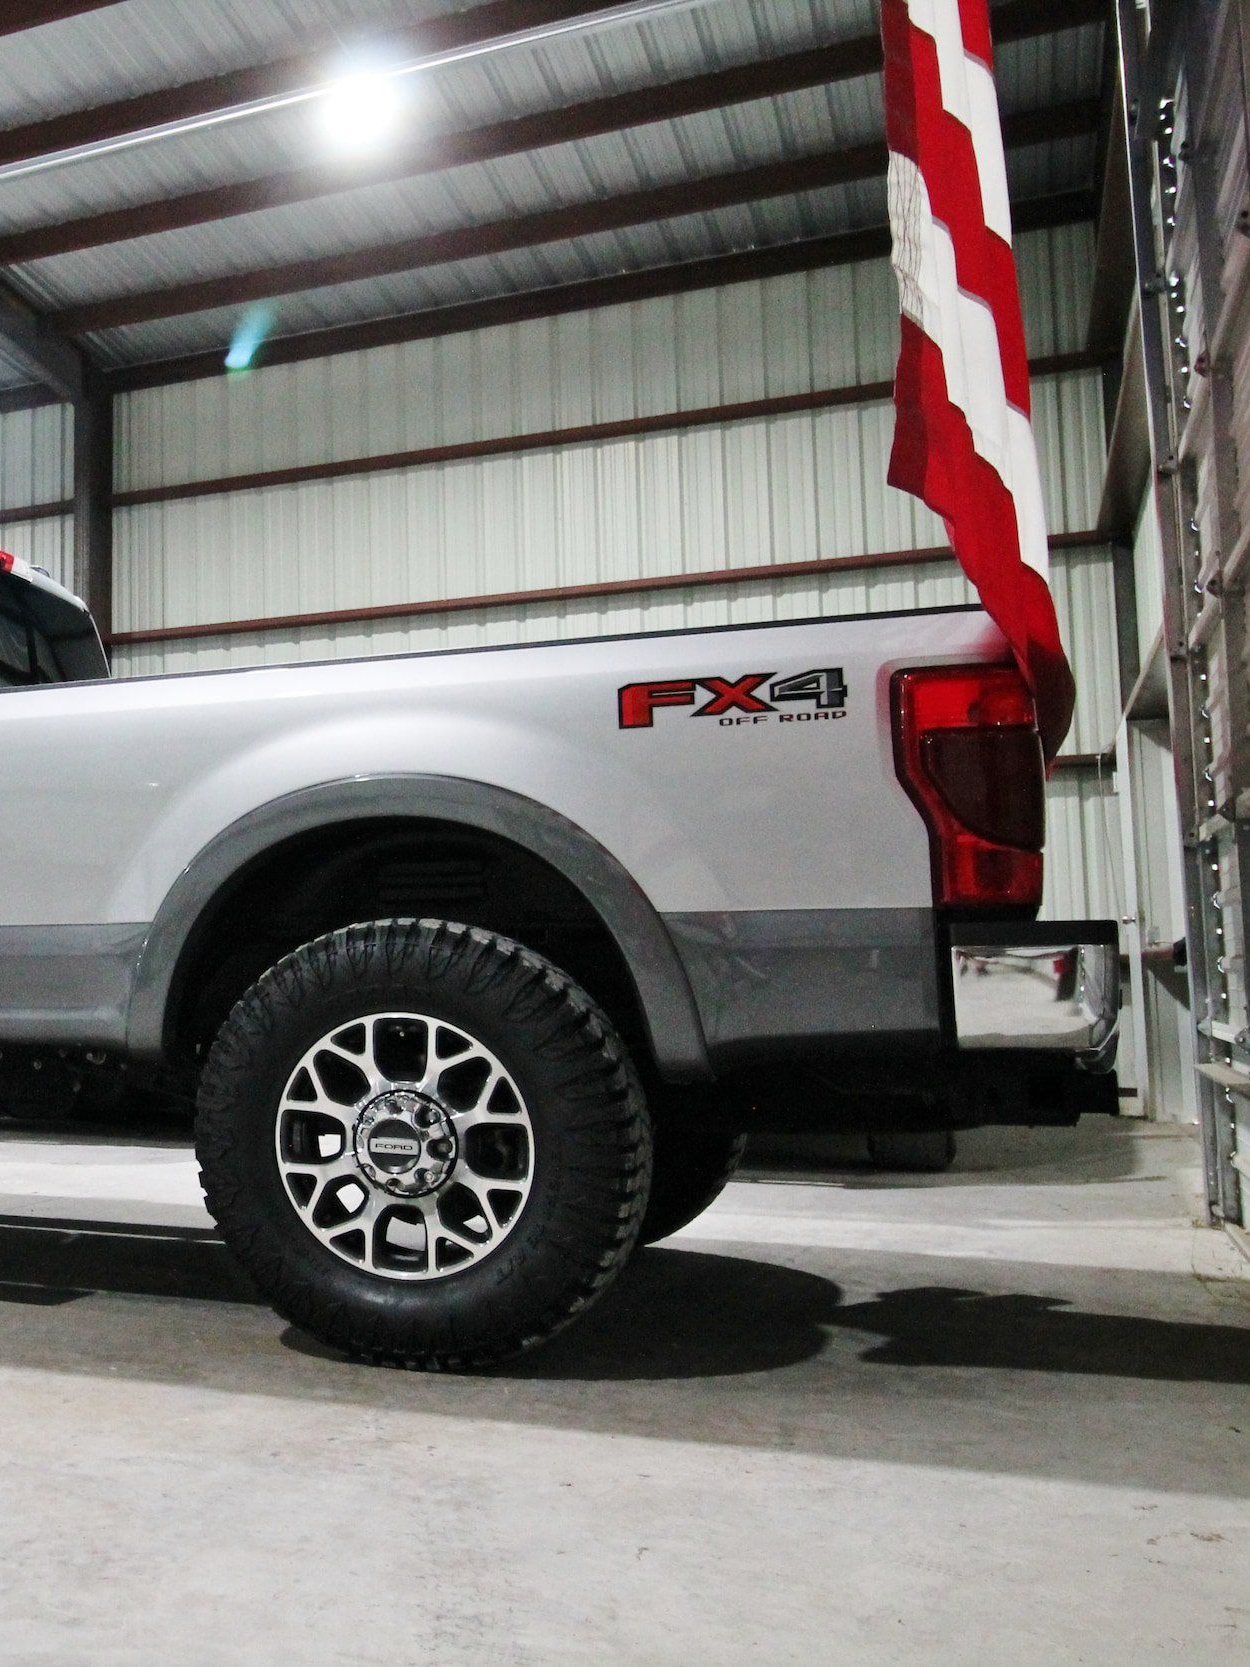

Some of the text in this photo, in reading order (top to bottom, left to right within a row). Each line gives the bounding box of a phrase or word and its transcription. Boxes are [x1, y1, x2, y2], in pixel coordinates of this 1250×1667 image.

[617, 667, 848, 730] FX4
[719, 711, 847, 727] OFF ROAD
[374, 1142, 413, 1151] FORD
